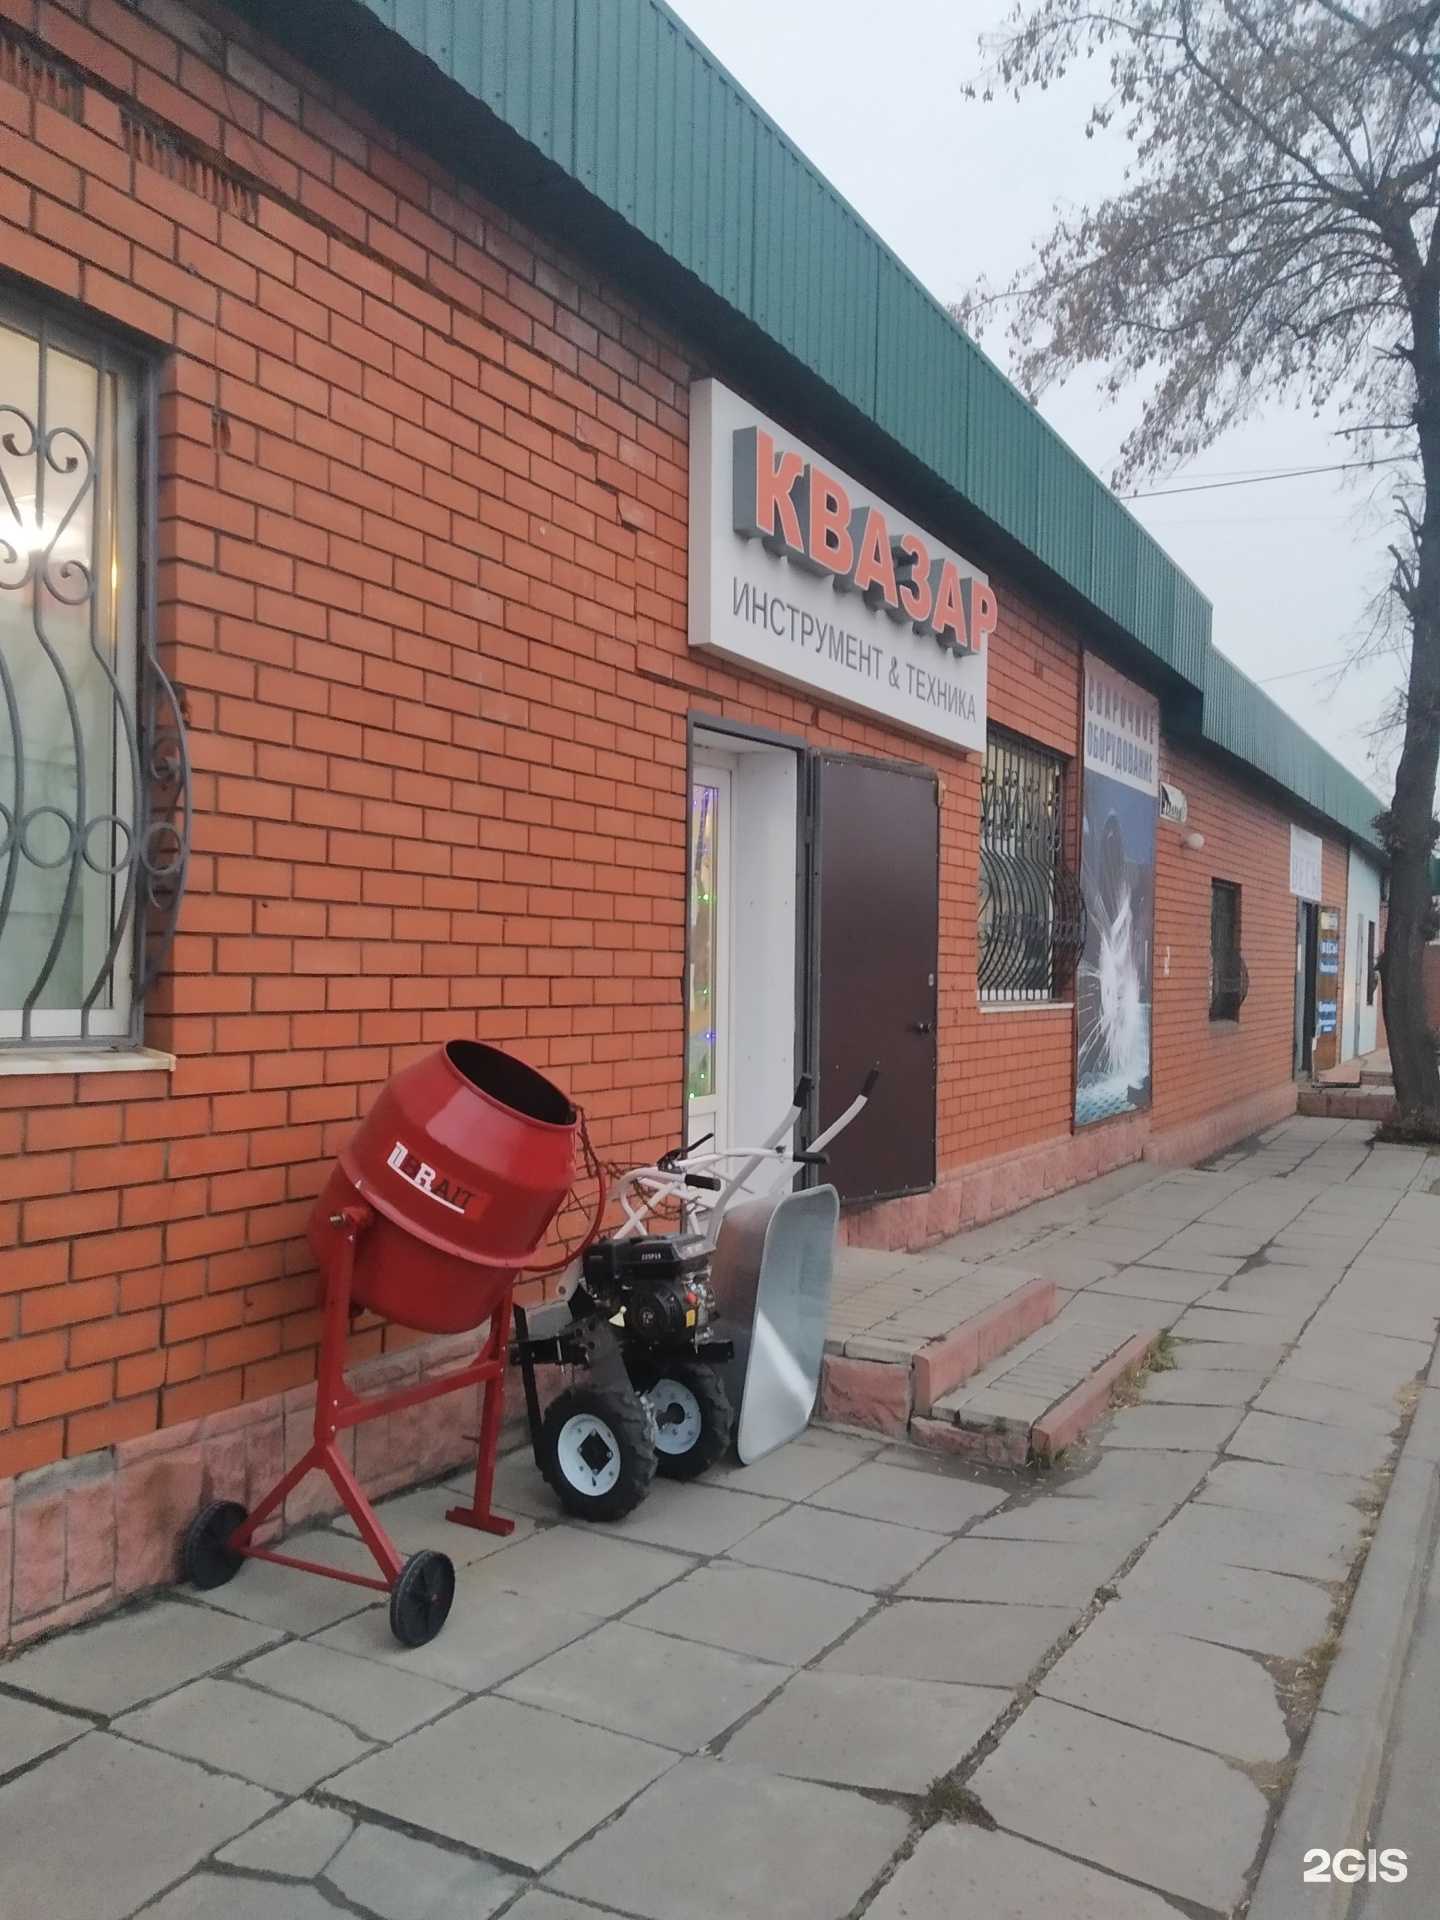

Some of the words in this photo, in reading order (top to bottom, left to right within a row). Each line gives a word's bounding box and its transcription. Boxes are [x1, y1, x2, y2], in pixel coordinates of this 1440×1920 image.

[750, 427, 998, 655] КВАЗАР
[732, 576, 884, 680] ИНСТРУМЕНТ
[888, 655, 901, 689] &
[905, 664, 977, 723] ТЕХНИКА
[1087, 721, 1153, 784] ОБОРУДОВАНИЕ
